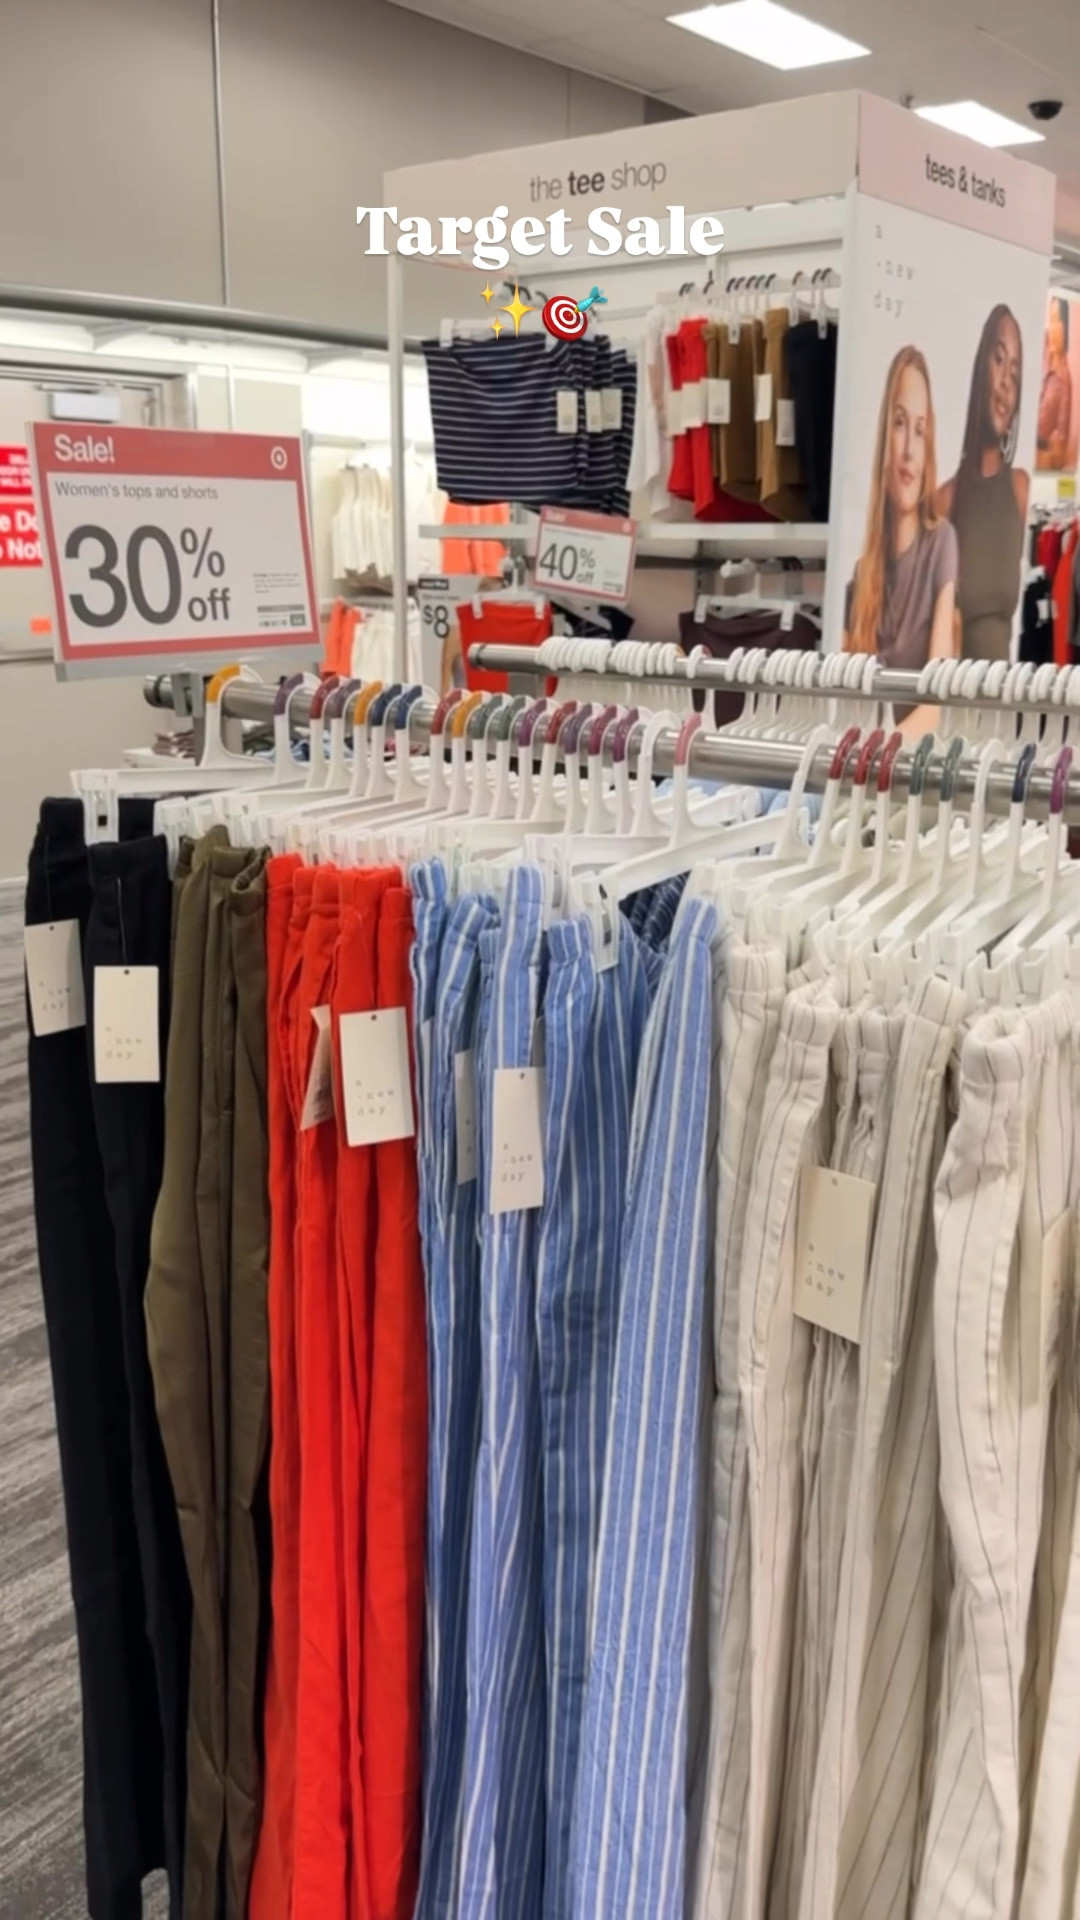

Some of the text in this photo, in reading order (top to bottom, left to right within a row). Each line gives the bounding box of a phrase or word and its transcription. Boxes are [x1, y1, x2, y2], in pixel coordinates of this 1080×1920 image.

[530, 161, 667, 202] the tee shop
[926, 153, 1006, 208] tees & tanks
[54, 433, 115, 463] Sale!
[55, 481, 219, 500] Women's tops and shorts
[576, 572, 595, 585] off
[187, 587, 231, 622] off
[423, 604, 450, 638] $8
